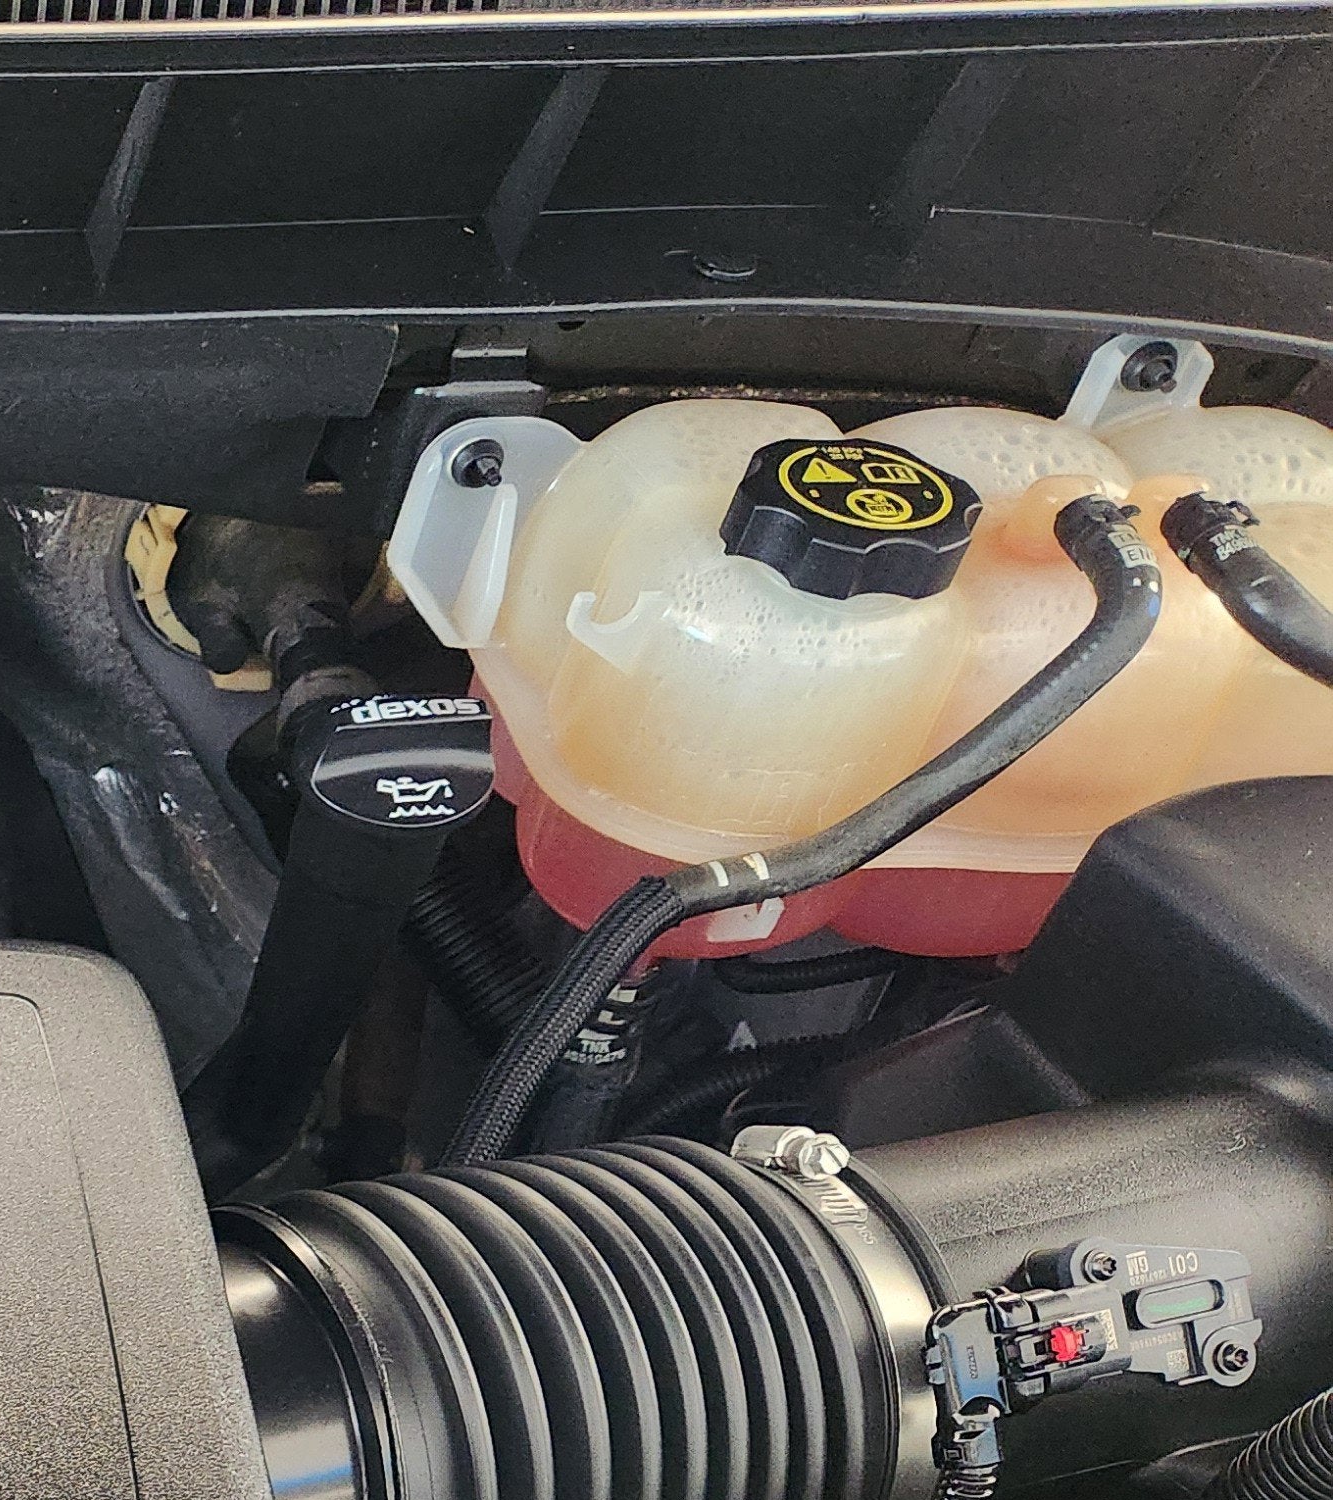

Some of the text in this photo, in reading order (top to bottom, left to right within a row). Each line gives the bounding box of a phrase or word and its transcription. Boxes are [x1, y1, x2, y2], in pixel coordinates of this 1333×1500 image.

[351, 698, 481, 724] dexos
[1126, 1253, 1150, 1277] GM
[1168, 1251, 1199, 1277] C01
